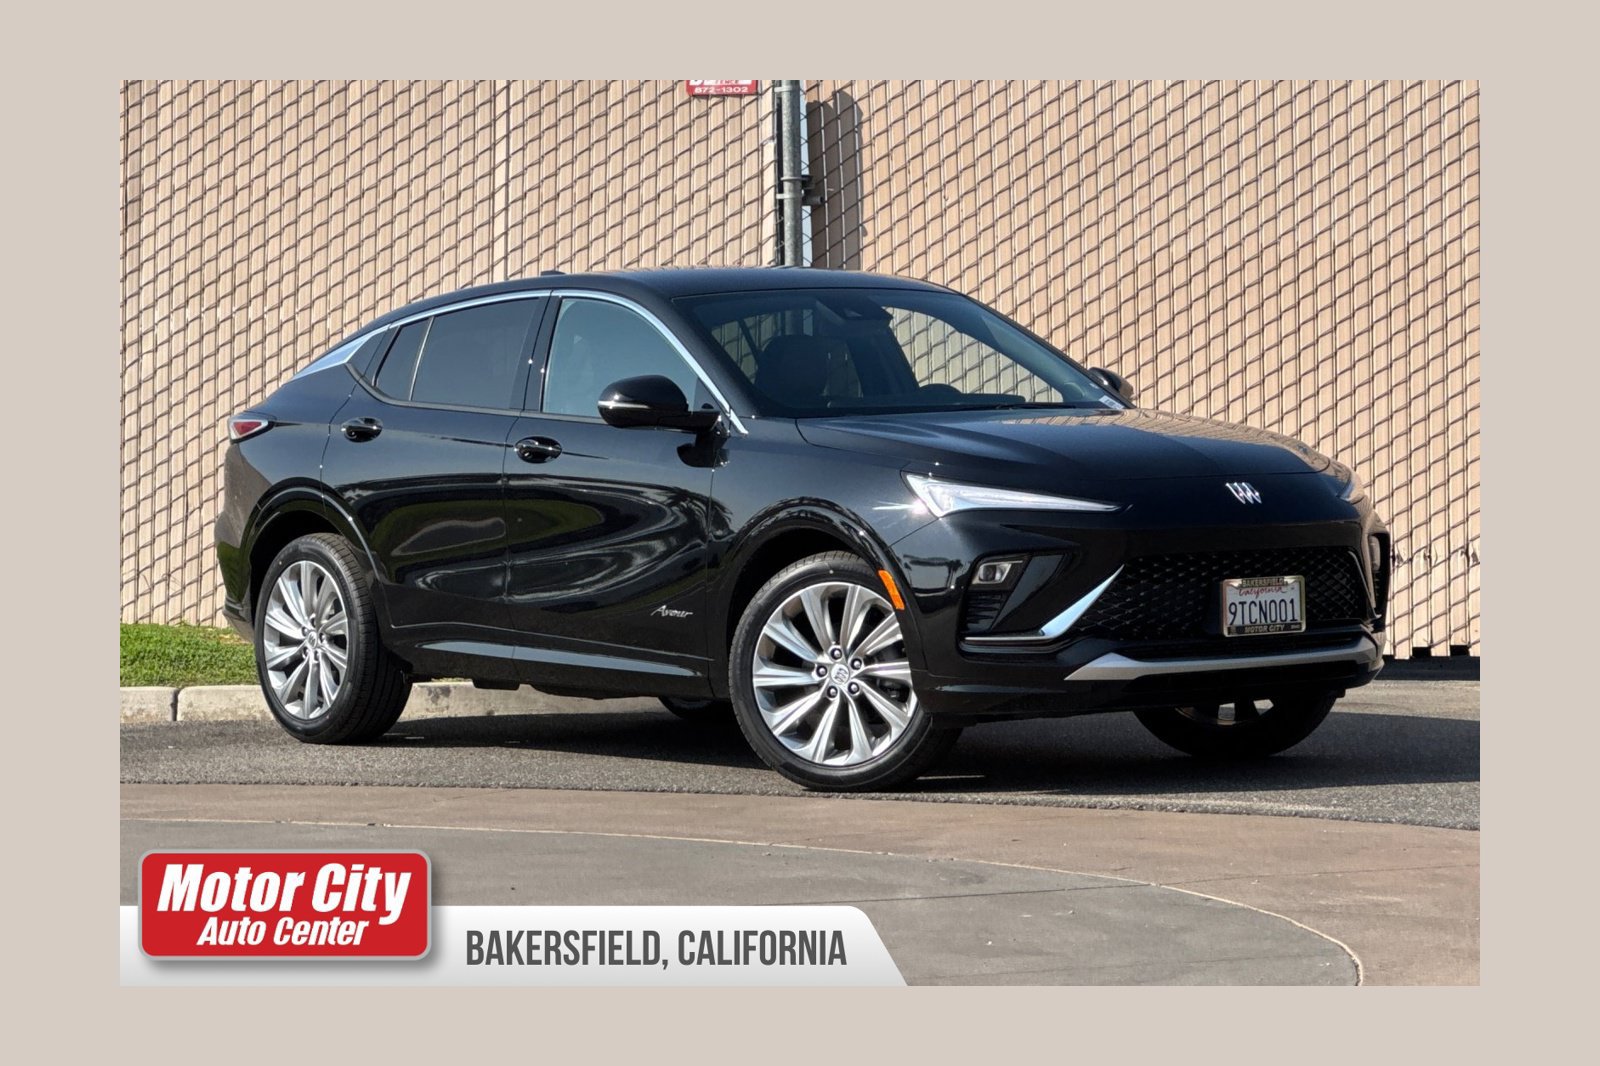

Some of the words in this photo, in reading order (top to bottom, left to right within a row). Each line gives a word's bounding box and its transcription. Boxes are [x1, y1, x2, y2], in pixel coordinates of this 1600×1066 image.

[1238, 586, 1286, 599] California
[1228, 598, 1298, 625] 9TCN001
[1244, 625, 1268, 633] MOTOR
[1268, 624, 1285, 632] CITY
